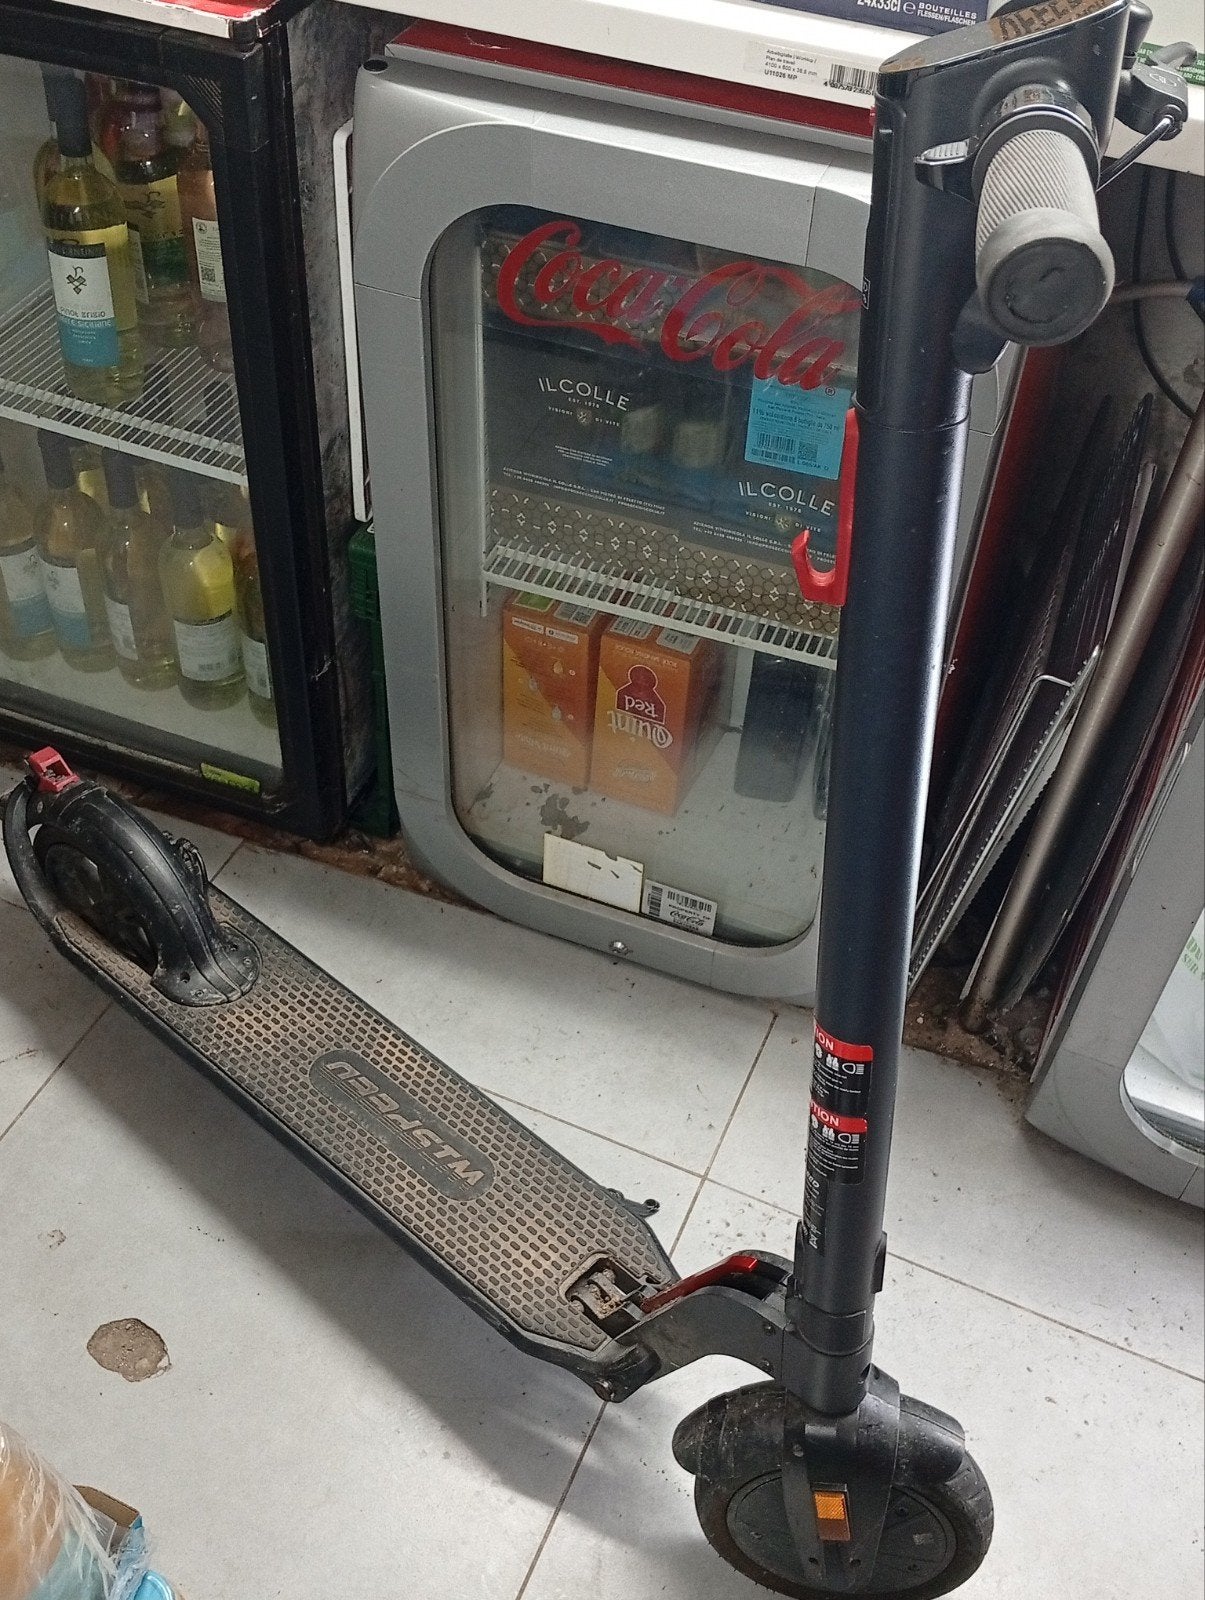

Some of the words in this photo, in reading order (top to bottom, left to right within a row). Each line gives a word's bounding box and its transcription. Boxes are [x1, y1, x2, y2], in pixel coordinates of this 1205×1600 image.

[917, 10, 977, 26] FLESSEN/FLASCHEN
[918, 2, 977, 19] BOUTEILLES
[496, 220, 862, 391] Coca-Cola
[624, 694, 659, 719] Red
[607, 709, 674, 749] Quint
[815, 1028, 834, 1051] ION
[324, 1061, 485, 1187] WISPEED
